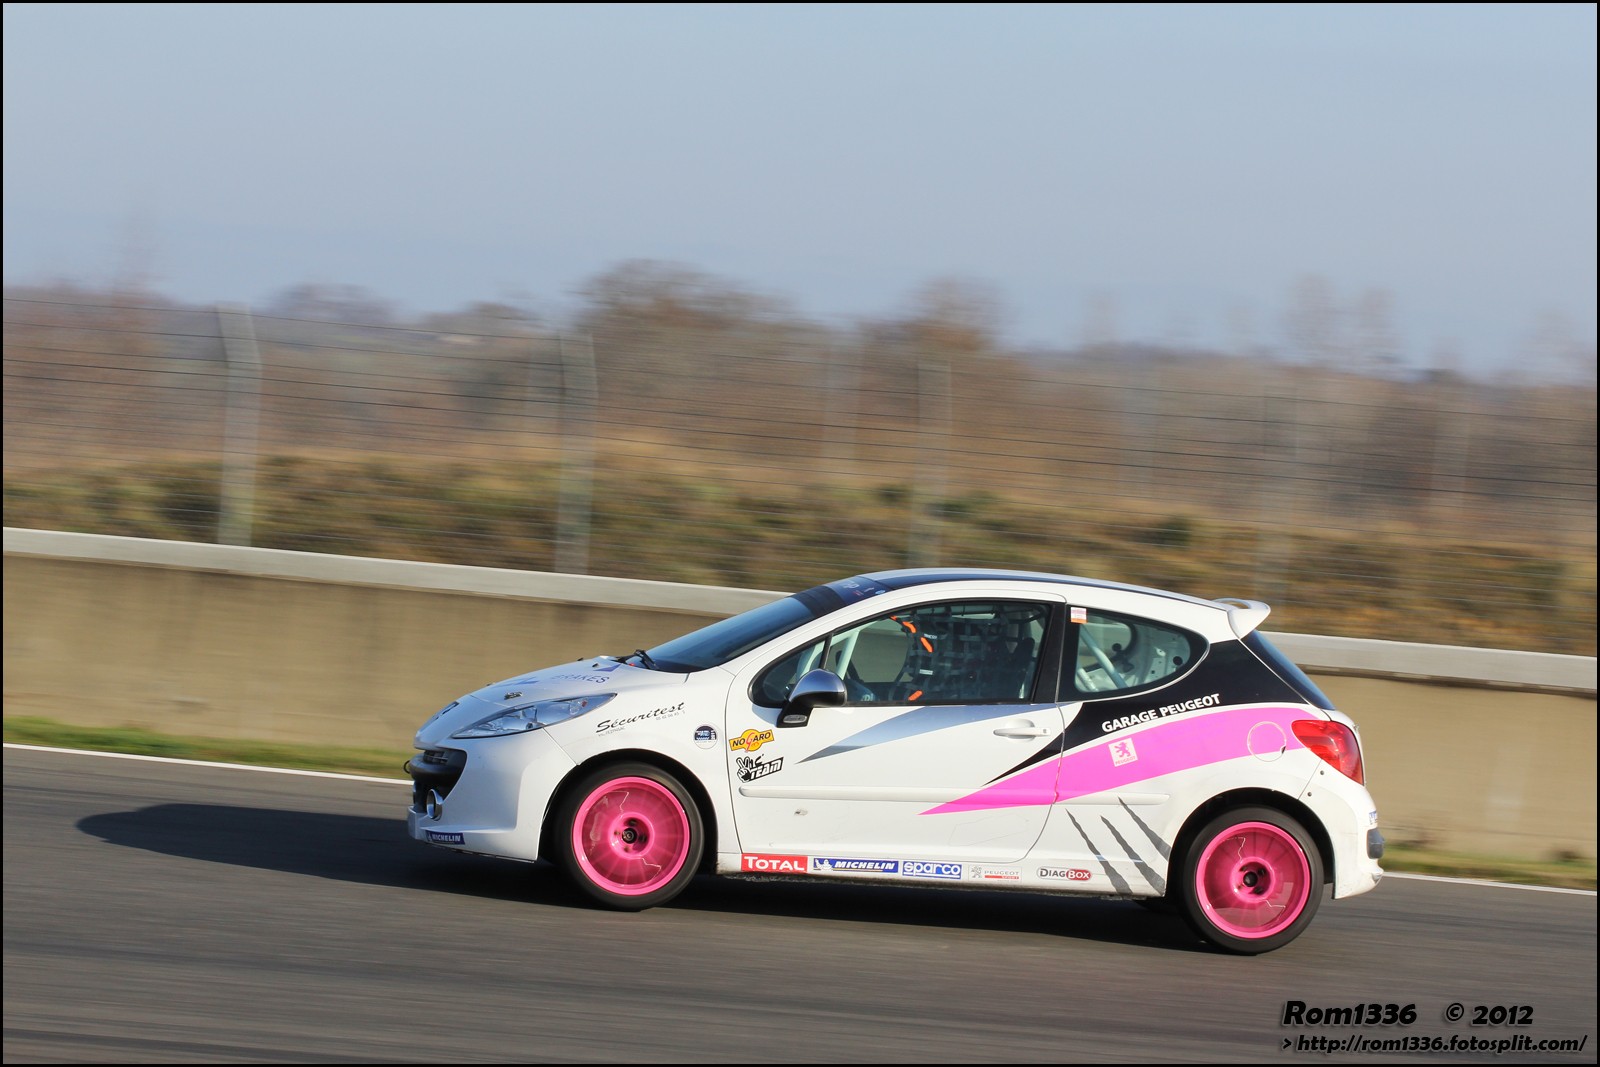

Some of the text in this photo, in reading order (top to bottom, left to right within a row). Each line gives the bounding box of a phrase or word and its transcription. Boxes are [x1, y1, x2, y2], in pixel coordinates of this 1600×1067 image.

[596, 702, 685, 733] Sécuritest
[1101, 693, 1220, 733] GARAGE PEUGEOT
[431, 833, 461, 842] MICHELIN
[744, 856, 805, 871] TOTAL
[834, 861, 895, 870] MICHELIN
[904, 861, 961, 877] sparco
